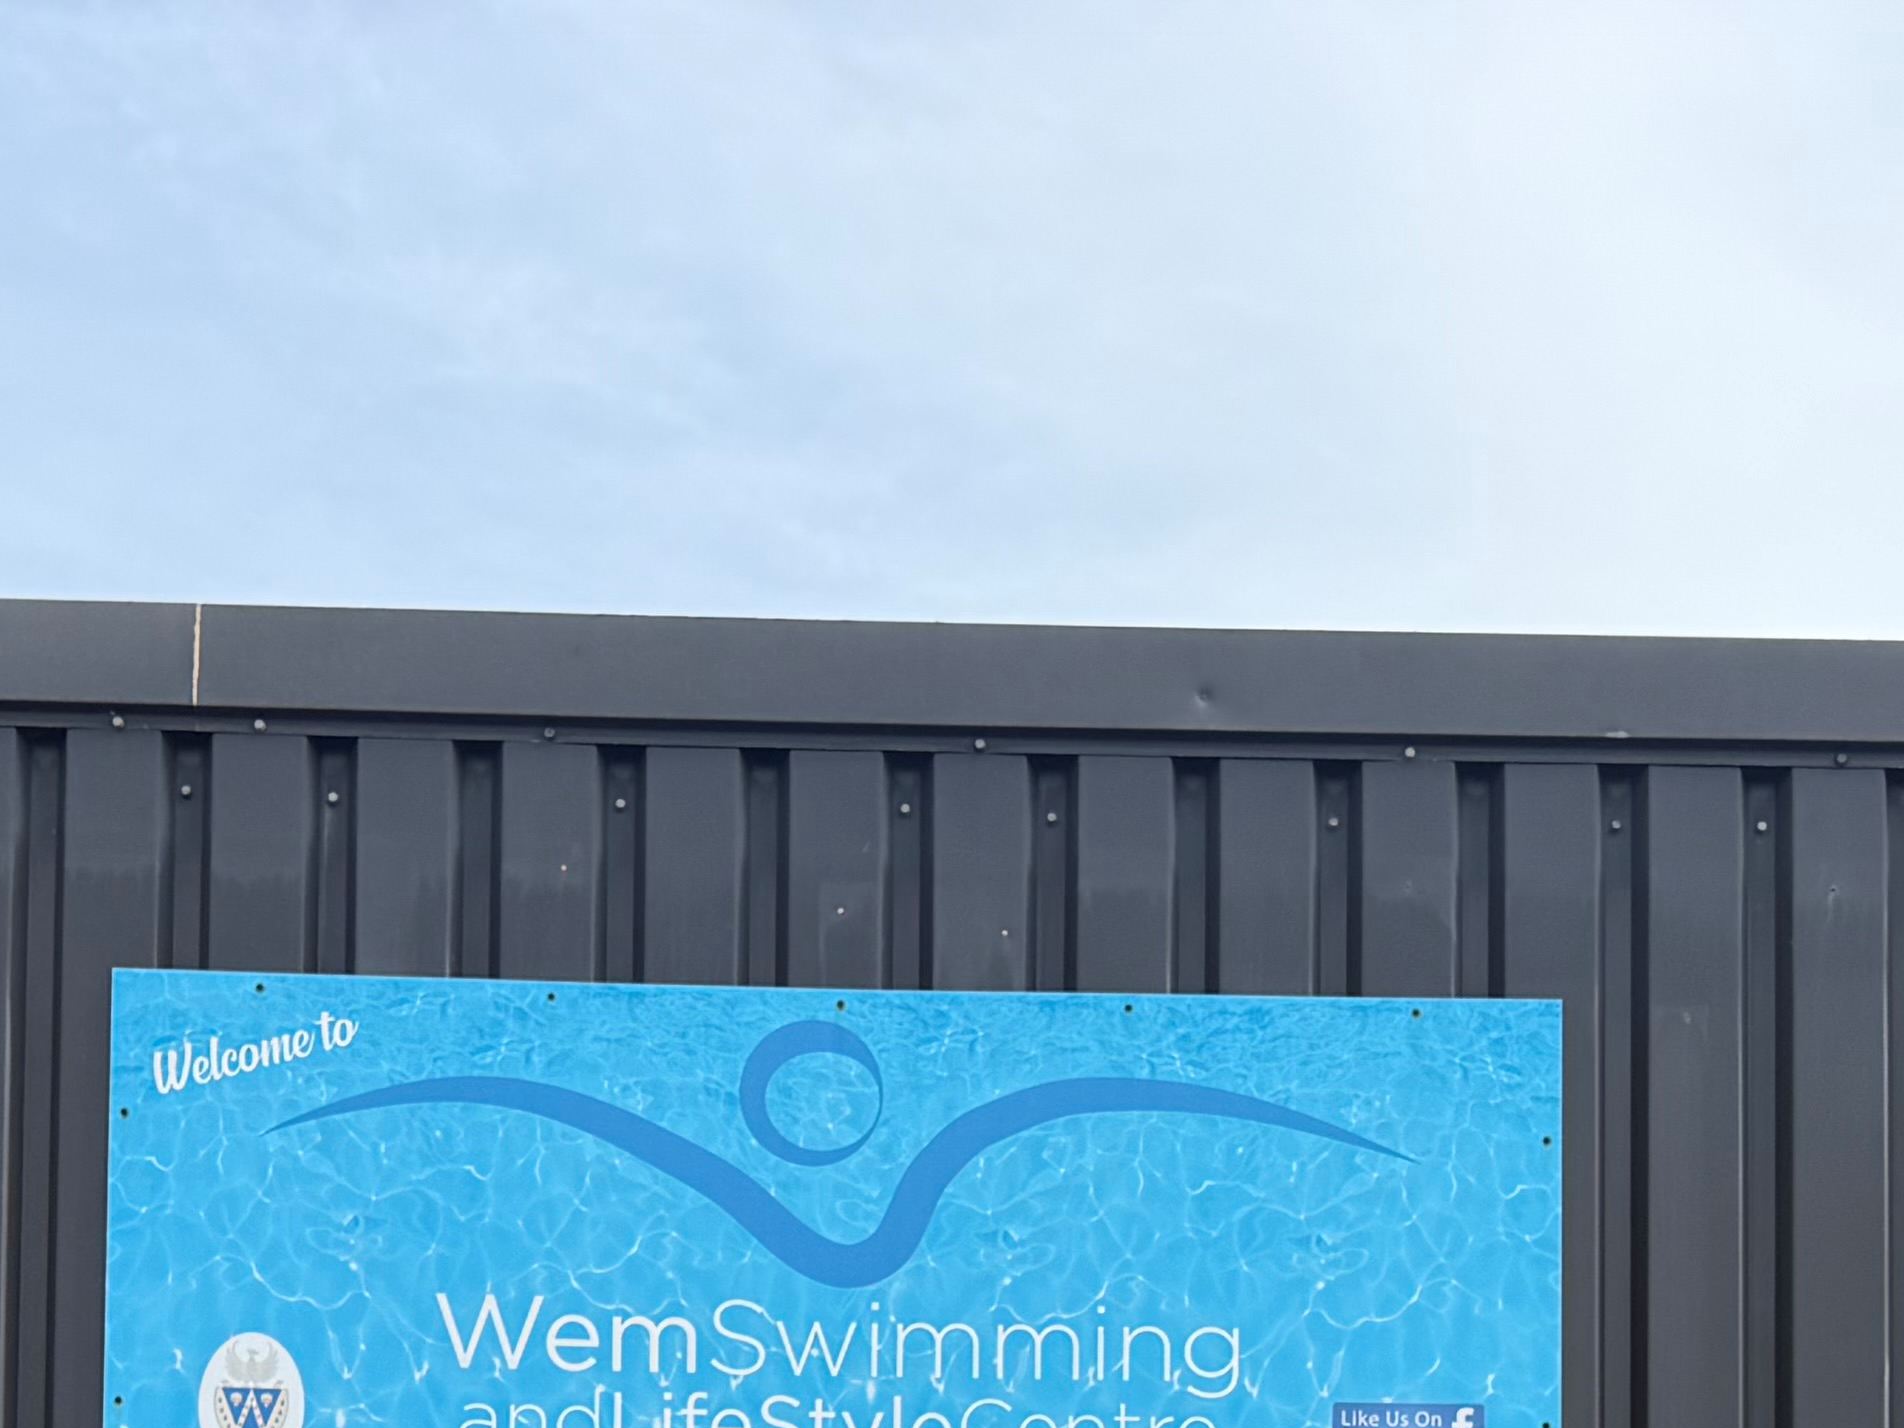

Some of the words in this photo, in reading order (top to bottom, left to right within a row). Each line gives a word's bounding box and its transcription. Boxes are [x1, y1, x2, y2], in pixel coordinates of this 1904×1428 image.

[153, 1029, 315, 1095] Welcome
[311, 1011, 359, 1051] to
[1341, 1410, 1379, 1428] Like
[1386, 1411, 1408, 1428] Us
[1415, 1411, 1442, 1428] On
